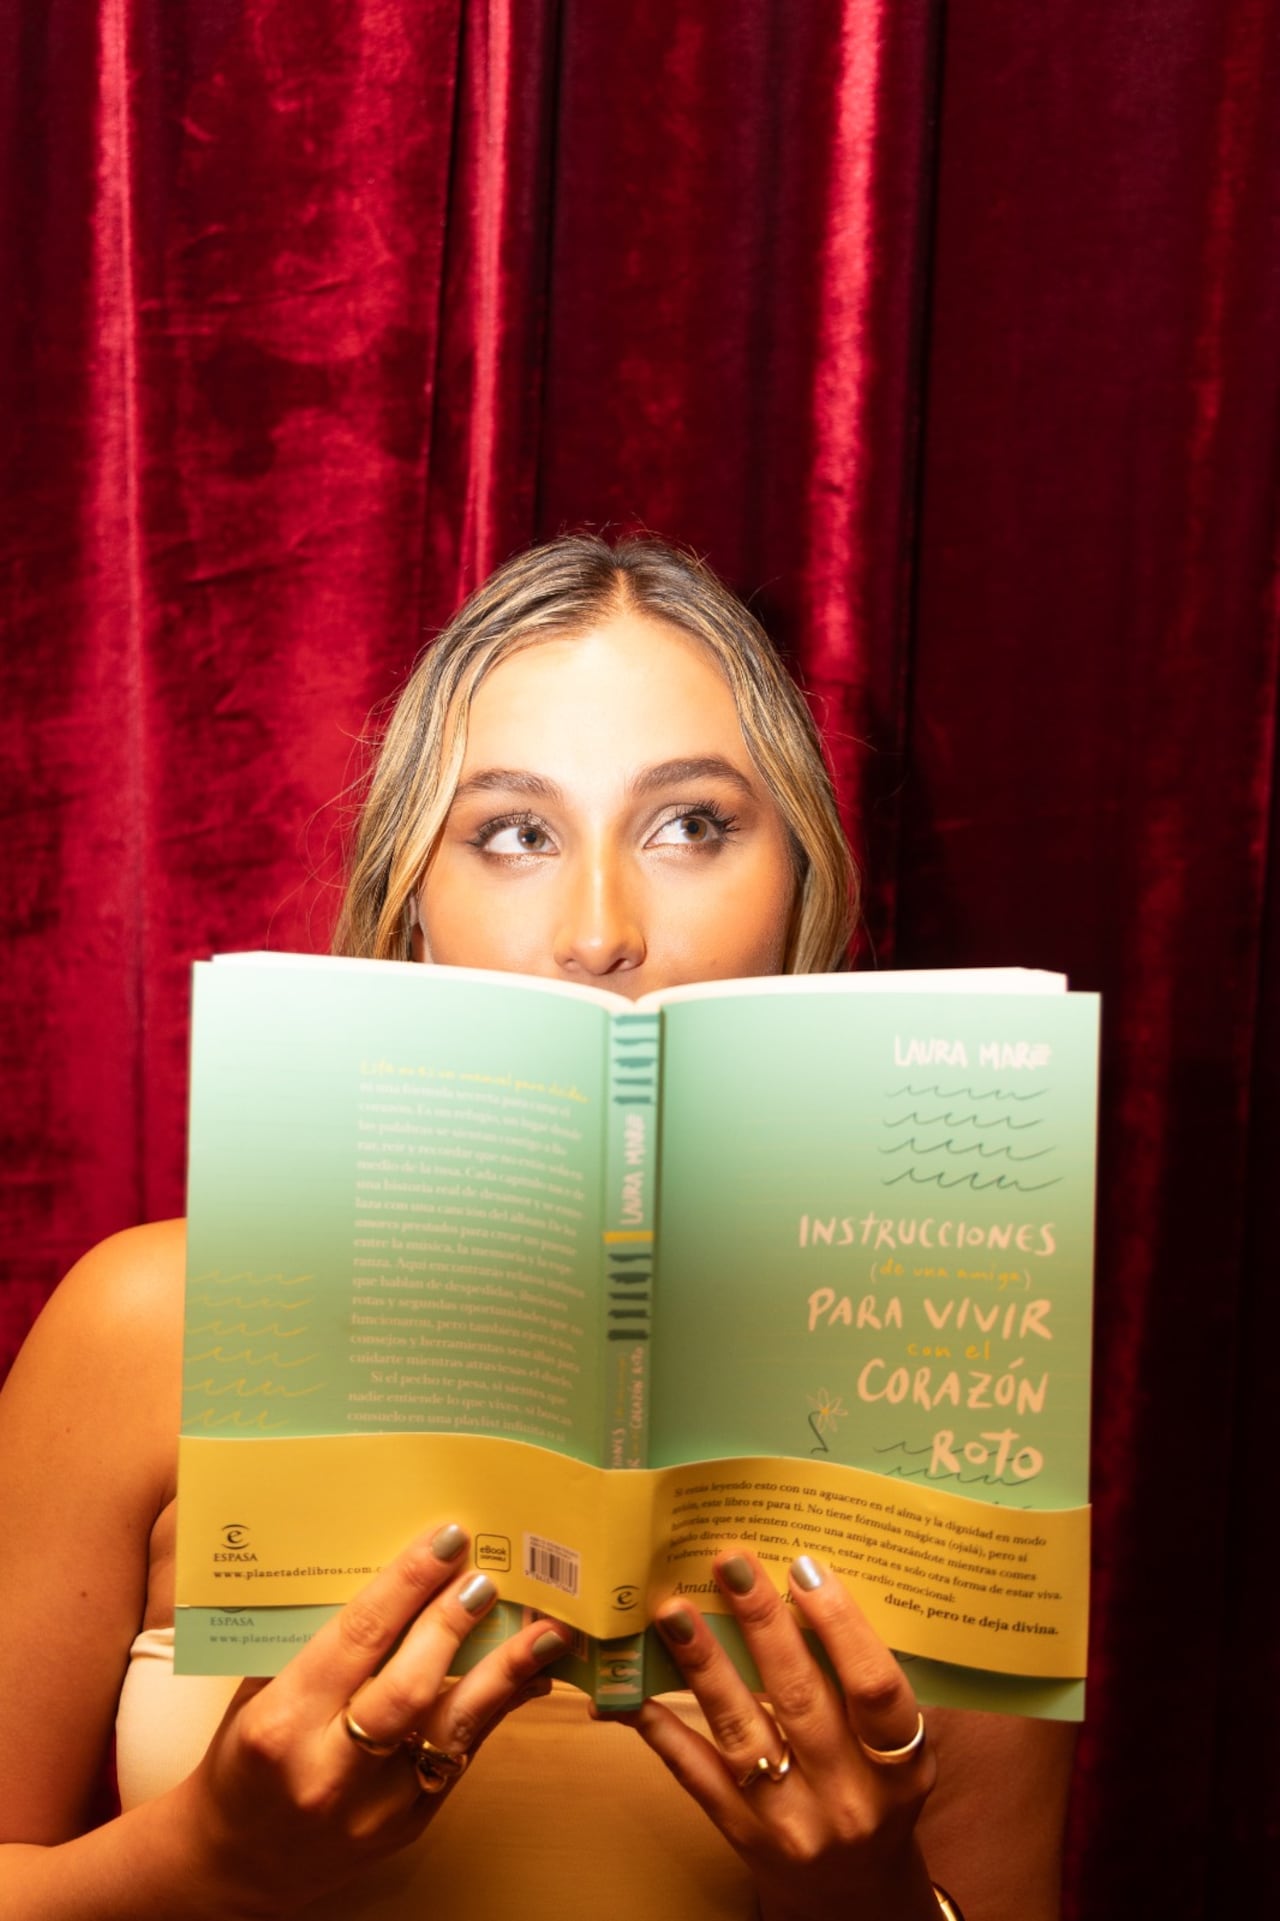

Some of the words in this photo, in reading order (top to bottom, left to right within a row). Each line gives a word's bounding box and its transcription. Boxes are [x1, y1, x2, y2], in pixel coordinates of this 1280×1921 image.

[894, 1035, 968, 1069] LAURA
[619, 1171, 644, 1225] LAURA
[799, 1210, 1056, 1256] INSTRUCCIONES
[913, 1264, 948, 1278] una
[807, 1287, 903, 1332] PARA
[923, 1297, 1053, 1340] VIVIR
[907, 1343, 952, 1358] con
[965, 1340, 990, 1360] el
[857, 1356, 1048, 1416] CORAZÓN
[930, 1428, 1044, 1480] ROTO
[712, 1481, 751, 1494] leyendo
[754, 1482, 777, 1491] esto
[780, 1483, 799, 1493] con
[803, 1486, 817, 1496] un
[819, 1491, 867, 1507] aguacero
[870, 1502, 882, 1511] en
[885, 1504, 894, 1514] el
[897, 1509, 922, 1522] alma
[925, 1517, 932, 1526] y
[934, 1517, 942, 1528] la
[945, 1521, 993, 1540] dignidad
[996, 1533, 1010, 1544] en
[1013, 1536, 1047, 1546] modo
[724, 1497, 749, 1506] libro
[752, 1499, 763, 1507] es
[766, 1500, 791, 1511] para
[807, 1504, 823, 1515] No
[826, 1506, 853, 1521] tiene
[988, 1550, 1015, 1562] pero
[213, 1553, 258, 1562] ESPASA
[701, 1531, 738, 1541] directo
[740, 1531, 757, 1541] del
[760, 1534, 789, 1545] tarro.
[792, 1538, 805, 1547] A
[804, 1542, 835, 1555] veces,
[838, 1547, 865, 1560] estar
[867, 1555, 888, 1567] rota
[890, 1560, 902, 1571] es
[904, 1565, 926, 1578] solo
[928, 1572, 950, 1584] otra
[953, 1576, 986, 1592] forma
[989, 1584, 1003, 1595] de
[1005, 1588, 1034, 1599] estar
[712, 1516, 731, 1526] que
[735, 1515, 745, 1523] se
[748, 1516, 788, 1527] sienten
[790, 1520, 821, 1533] como
[824, 1527, 844, 1538] una
[846, 1531, 878, 1546] amiga
[880, 1541, 945, 1564] abrazándote
[948, 1558, 997, 1576] mientras
[1000, 1570, 1037, 1581] comes
[757, 1551, 780, 1562] tusa
[861, 1570, 894, 1587] cardio
[897, 1580, 956, 1603] emocional:
[210, 1617, 254, 1626] ESPASA
[884, 1593, 924, 1614] duele,
[927, 1606, 959, 1621] pero
[962, 1613, 976, 1624] te
[979, 1616, 1009, 1632] deja
[1012, 1621, 1059, 1635] divina.
